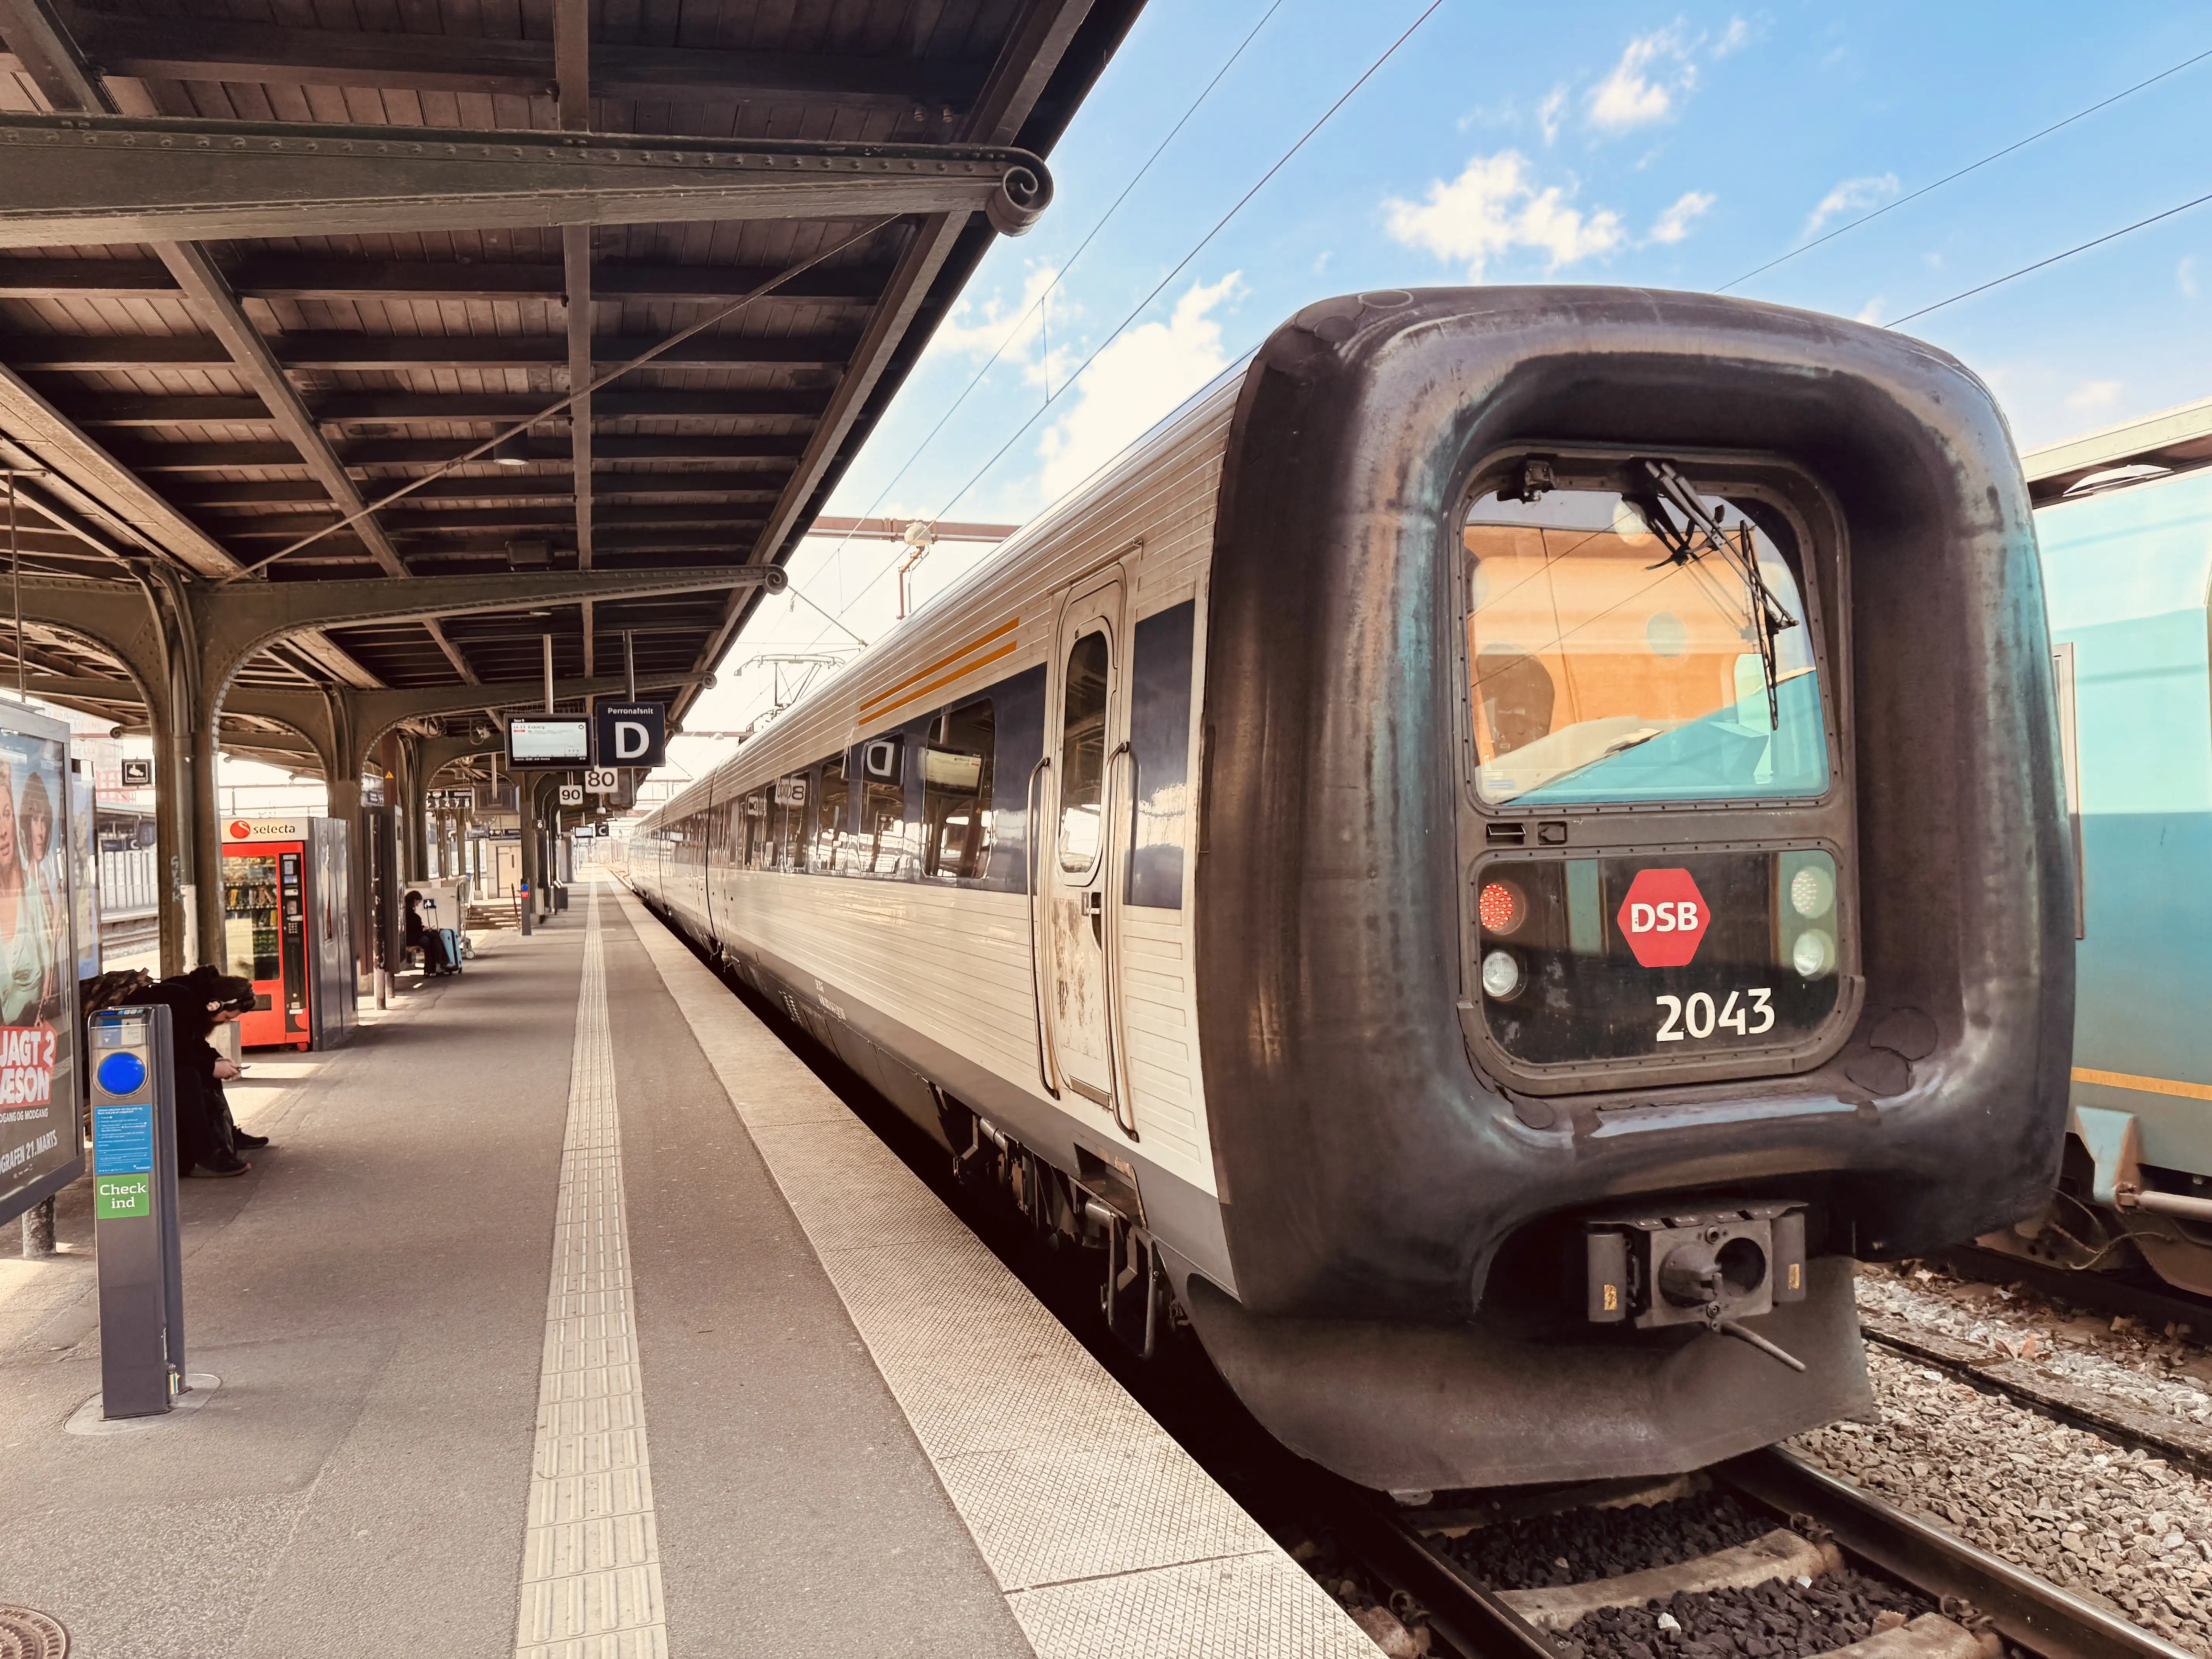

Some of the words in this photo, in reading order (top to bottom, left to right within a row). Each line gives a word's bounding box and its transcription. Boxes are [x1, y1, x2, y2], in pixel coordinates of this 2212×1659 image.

[615, 722, 649, 758] D
[588, 772, 615, 787] 80
[562, 790, 580, 800] 90
[253, 824, 295, 834] selecta
[599, 826, 606, 835] C
[1631, 902, 1698, 933] DSB
[1656, 988, 1775, 1042] 2043
[0, 1030, 41, 1067] JAGT
[43, 1031, 55, 1067] 2
[17, 1110, 24, 1121] OG
[0, 1145, 25, 1175] GRAFEN
[100, 1182, 146, 1195] Check
[112, 1196, 135, 1209] ind
